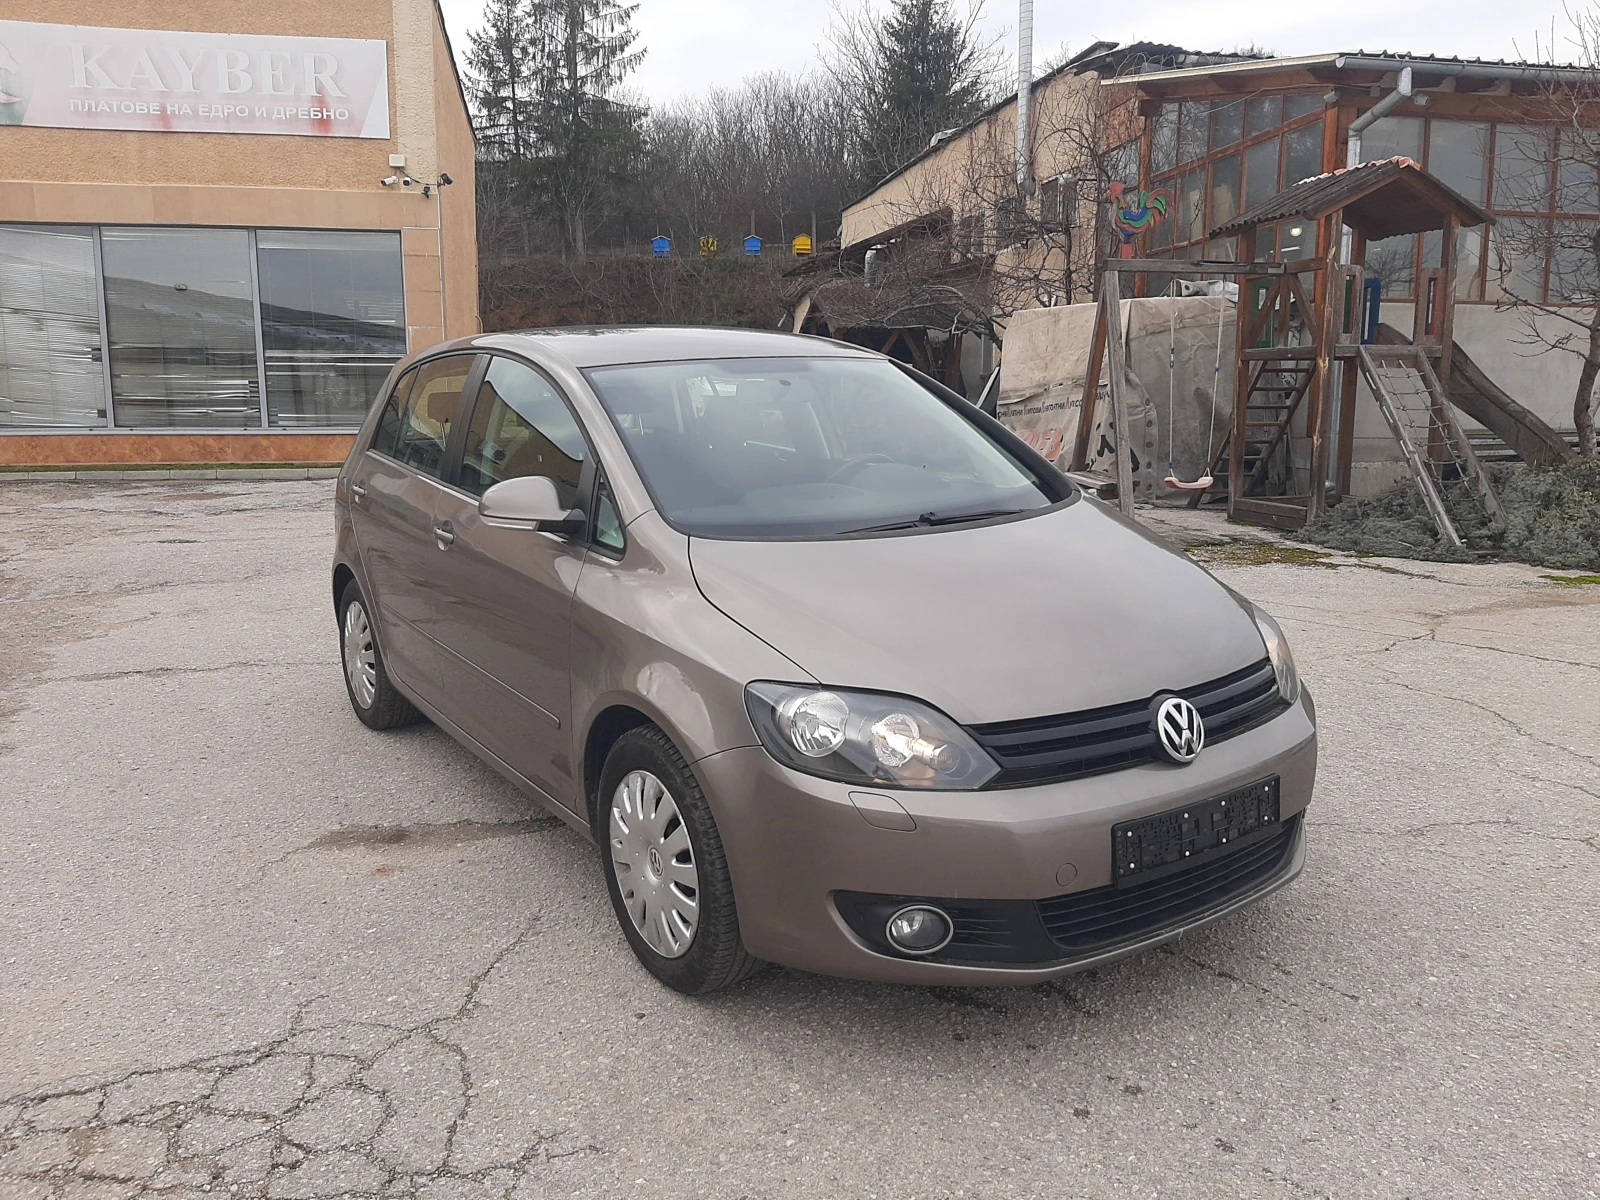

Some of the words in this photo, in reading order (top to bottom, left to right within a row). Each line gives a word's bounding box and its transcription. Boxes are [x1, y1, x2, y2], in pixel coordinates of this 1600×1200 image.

[69, 41, 347, 98] KAYBER
[69, 99, 160, 115] ПЛАТОВЕ
[166, 103, 193, 116] НА
[199, 104, 249, 119] ЕДРО
[255, 105, 267, 118] И
[272, 106, 349, 121] ДРЕБНО
[1157, 697, 1204, 763] VW
